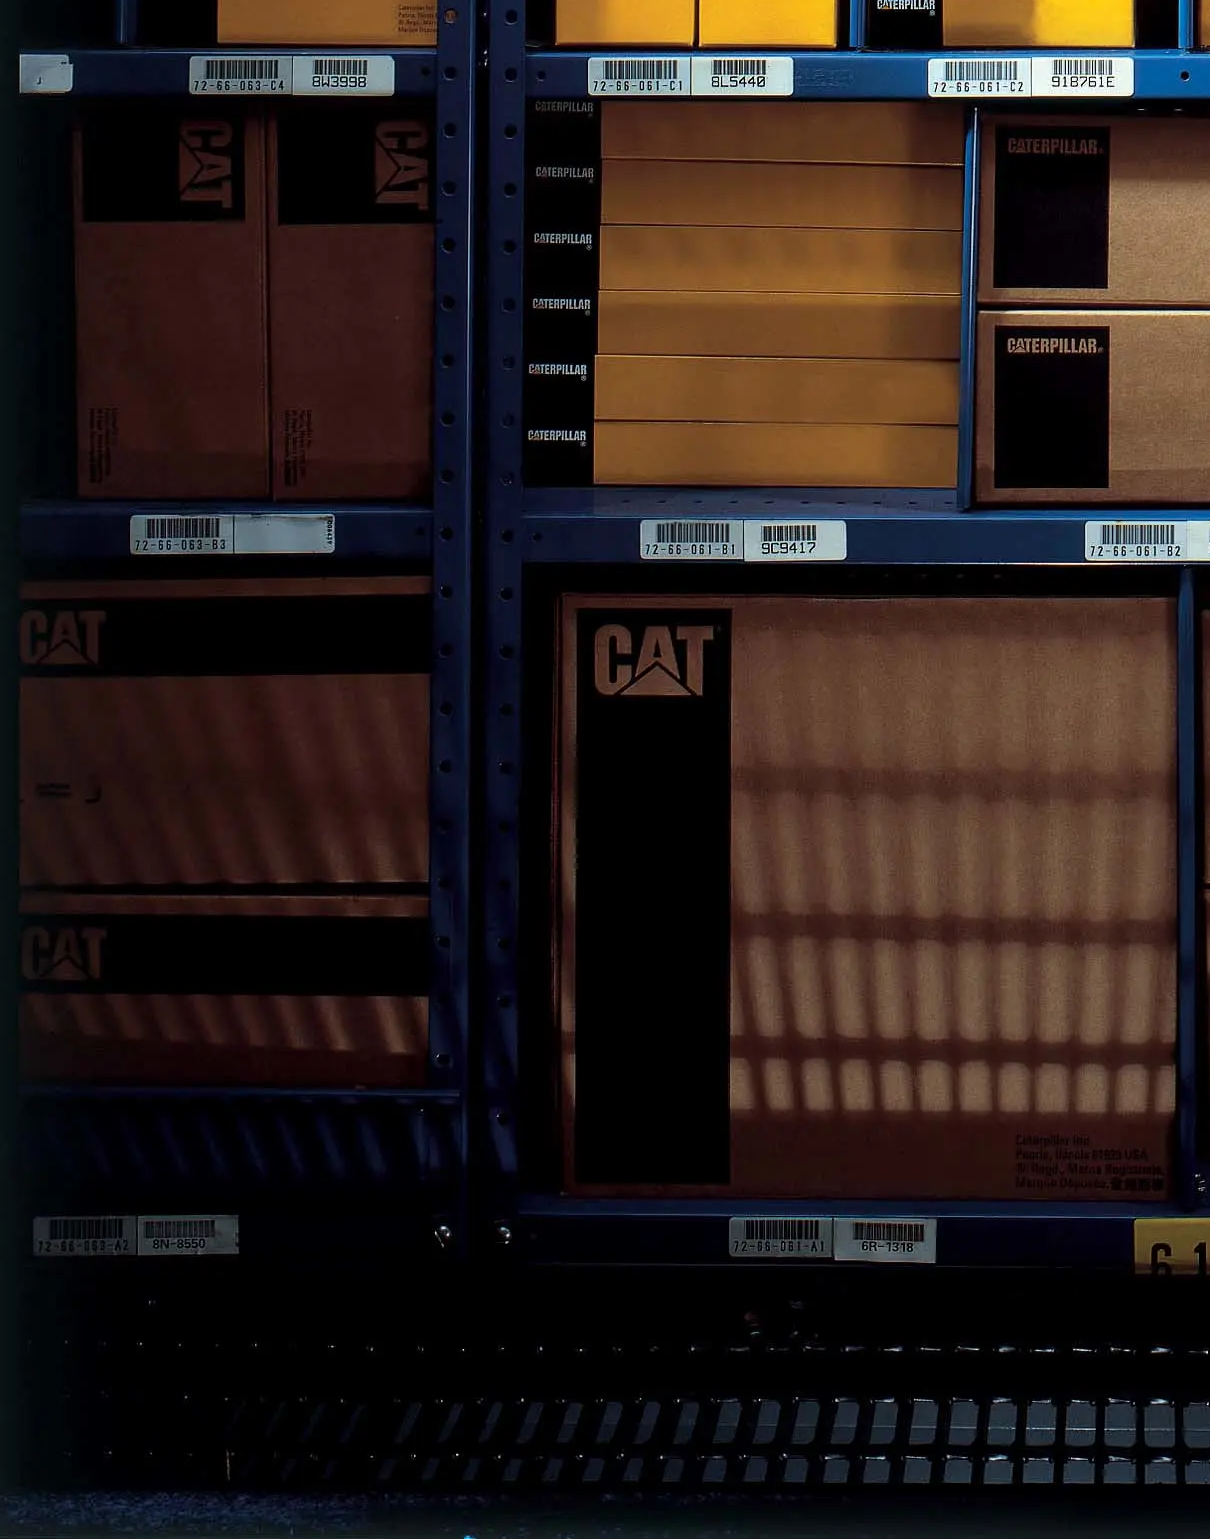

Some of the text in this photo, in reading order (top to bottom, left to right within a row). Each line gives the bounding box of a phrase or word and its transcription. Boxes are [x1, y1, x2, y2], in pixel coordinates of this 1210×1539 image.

[194, 80, 284, 91] 72-66-063-C4
[312, 76, 366, 87] 8W3998
[593, 79, 682, 91] 72-66-061-C1
[712, 75, 765, 87] 8L5440
[933, 80, 1024, 92] 72-66-061-C2
[535, 101, 594, 113] CATERPILLAR
[1008, 137, 1100, 155] CATERPILLAR
[179, 119, 234, 209] CAT
[375, 119, 429, 210] CAT
[535, 166, 594, 178] CATERPILLAR
[534, 232, 592, 245] CATERPILLAR
[532, 297, 590, 310] CATERPILLAR
[1007, 337, 1102, 355] CATERPILLAR
[529, 363, 587, 376] CATERPILLAR
[527, 429, 586, 441] CATERPILLAR
[135, 539, 225, 550] 72-66-063-B3
[646, 543, 735, 554] 72-66-061-B1
[761, 541, 815, 554] 9C9417
[1090, 544, 1180, 557] 72-66-061-B2
[20, 610, 106, 666] CAT
[594, 623, 713, 697] CAT
[21, 925, 107, 982] CAT
[153, 1238, 205, 1249] 8N-8550
[734, 1240, 824, 1252] 72-66-061-A1
[862, 1240, 914, 1252] 6R-1318
